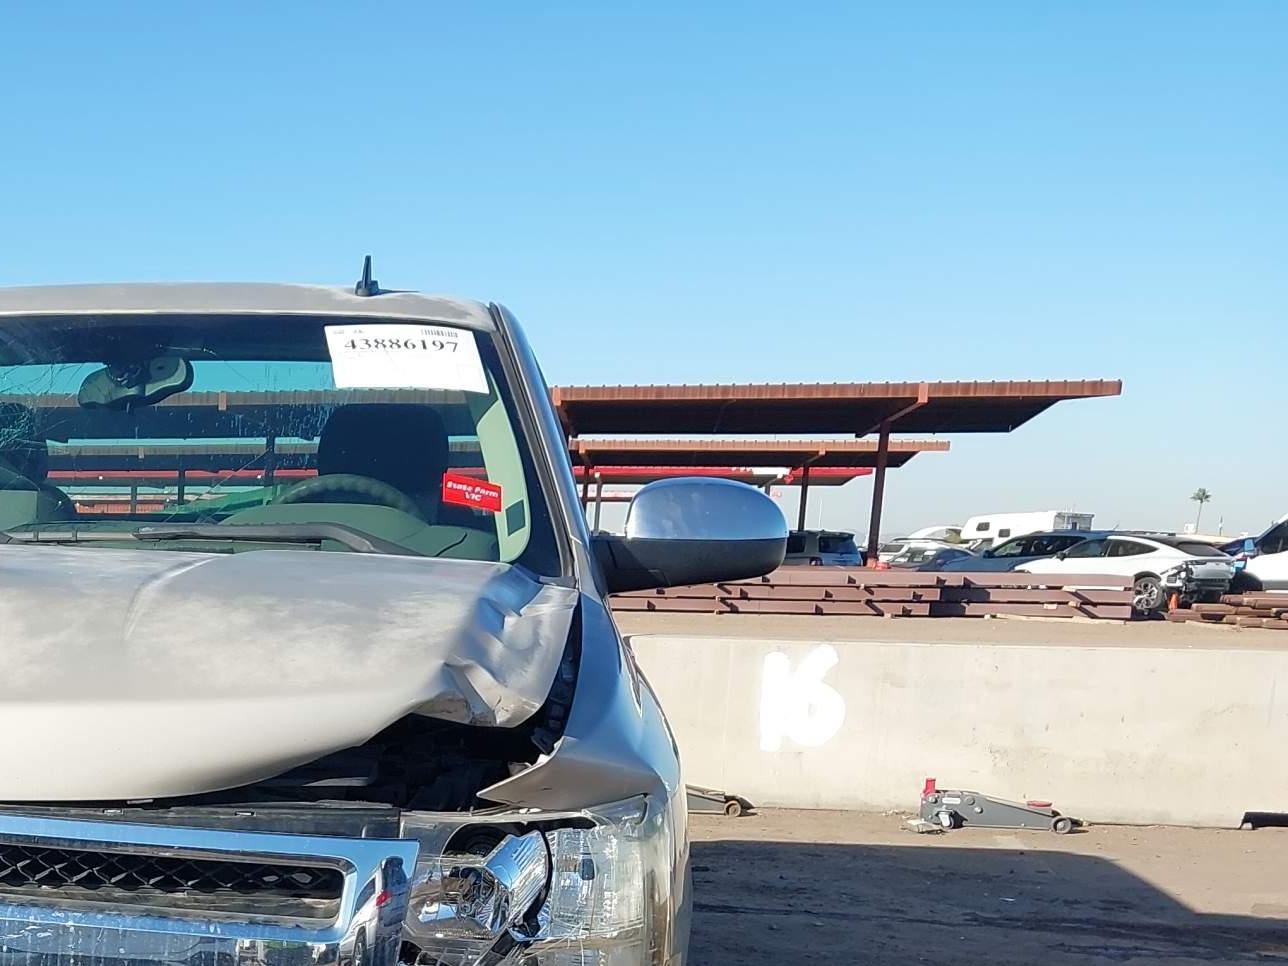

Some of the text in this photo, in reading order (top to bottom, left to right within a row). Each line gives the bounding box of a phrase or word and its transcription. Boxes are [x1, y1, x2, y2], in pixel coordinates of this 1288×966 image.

[344, 337, 459, 353] 43886197
[447, 481, 499, 499] State Farm
[760, 643, 846, 752] 16
